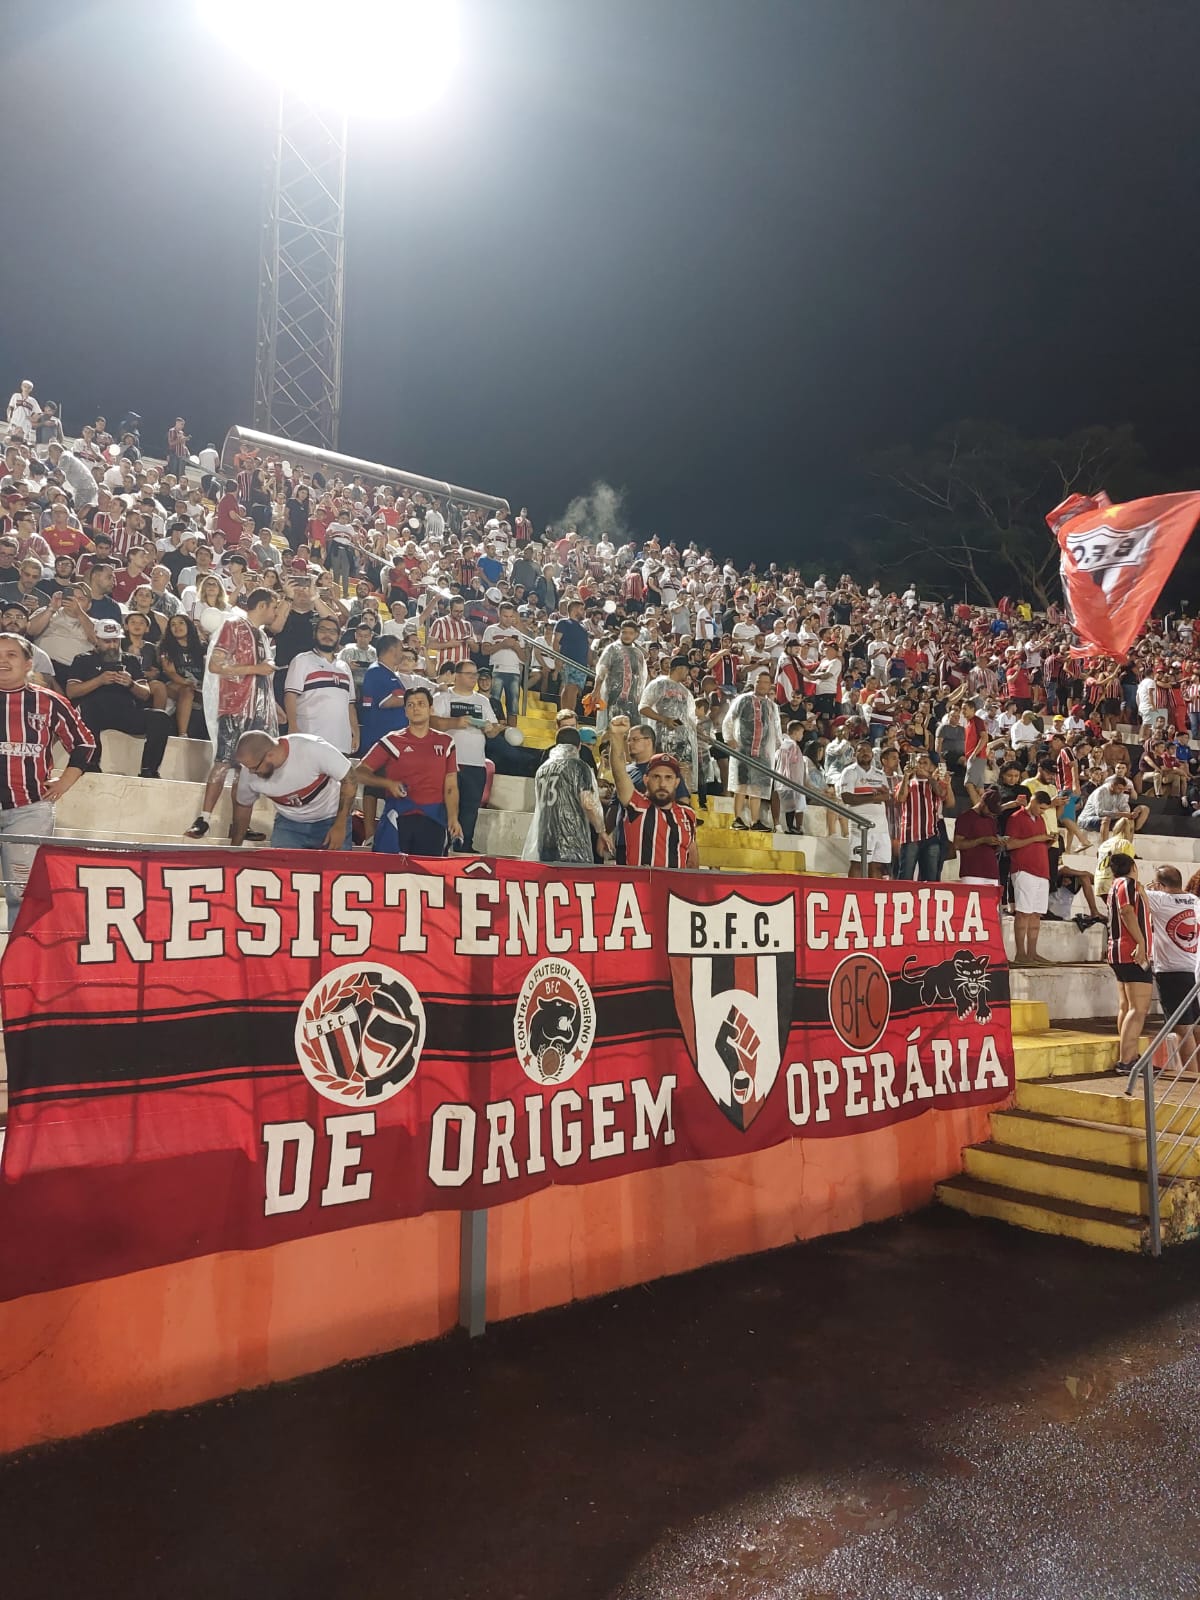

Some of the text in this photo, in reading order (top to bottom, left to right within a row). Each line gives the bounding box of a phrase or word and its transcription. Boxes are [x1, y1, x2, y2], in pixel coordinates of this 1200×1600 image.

[78, 862, 991, 963] RESISTÊNCIA CAIPIRA
[690, 911, 780, 949] B.F.C.
[517, 963, 592, 1050] CONTRA O FUTEBOL MODERNO
[545, 981, 561, 995] BFC
[840, 965, 880, 1038] BFC
[263, 1026, 1009, 1216] DE ORIGEM OPERÁRIA
